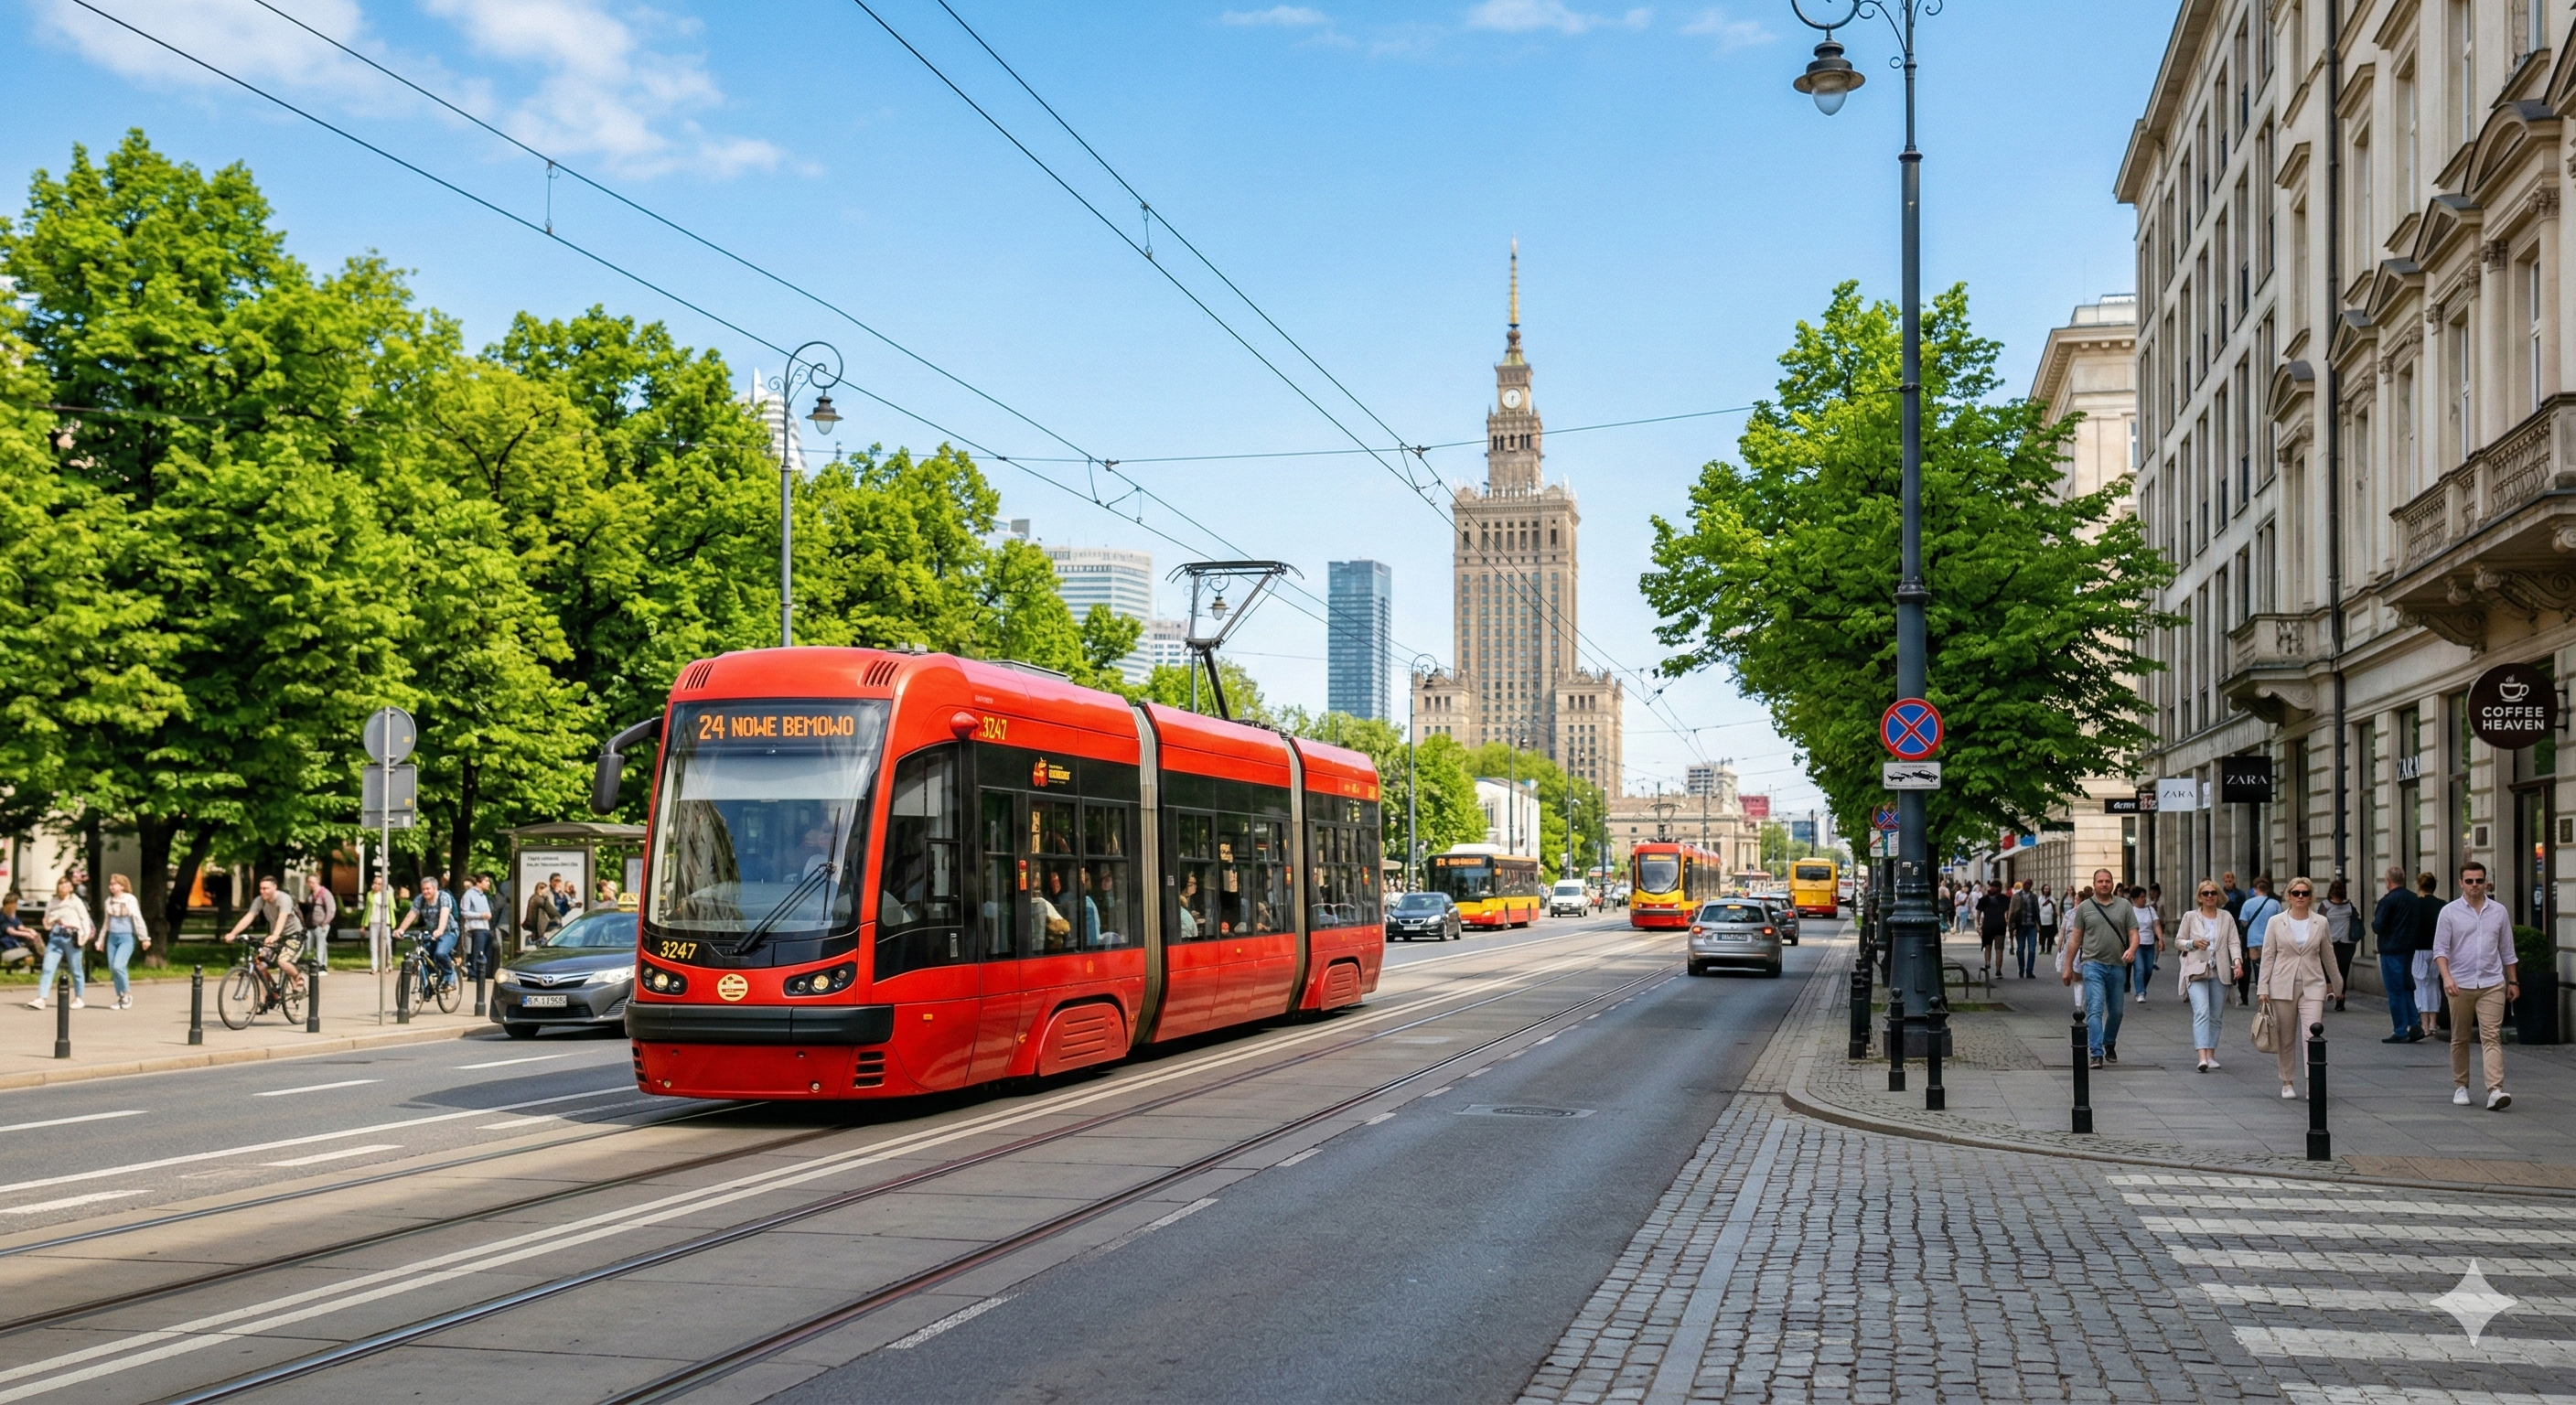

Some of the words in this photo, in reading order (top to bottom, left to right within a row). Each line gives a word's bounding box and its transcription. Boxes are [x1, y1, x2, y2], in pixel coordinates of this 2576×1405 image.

[2482, 706, 2544, 717] COFFEE
[699, 714, 725, 740] 24
[732, 716, 778, 737] NOWE
[782, 715, 854, 737] BEMOWO
[982, 715, 1007, 740] 3247
[2482, 719, 2544, 731] HEAVEN
[2397, 756, 2420, 781] ZARA
[2226, 775, 2268, 785] ZARA
[2163, 790, 2194, 799] ZARA
[660, 940, 697, 960] 3247
